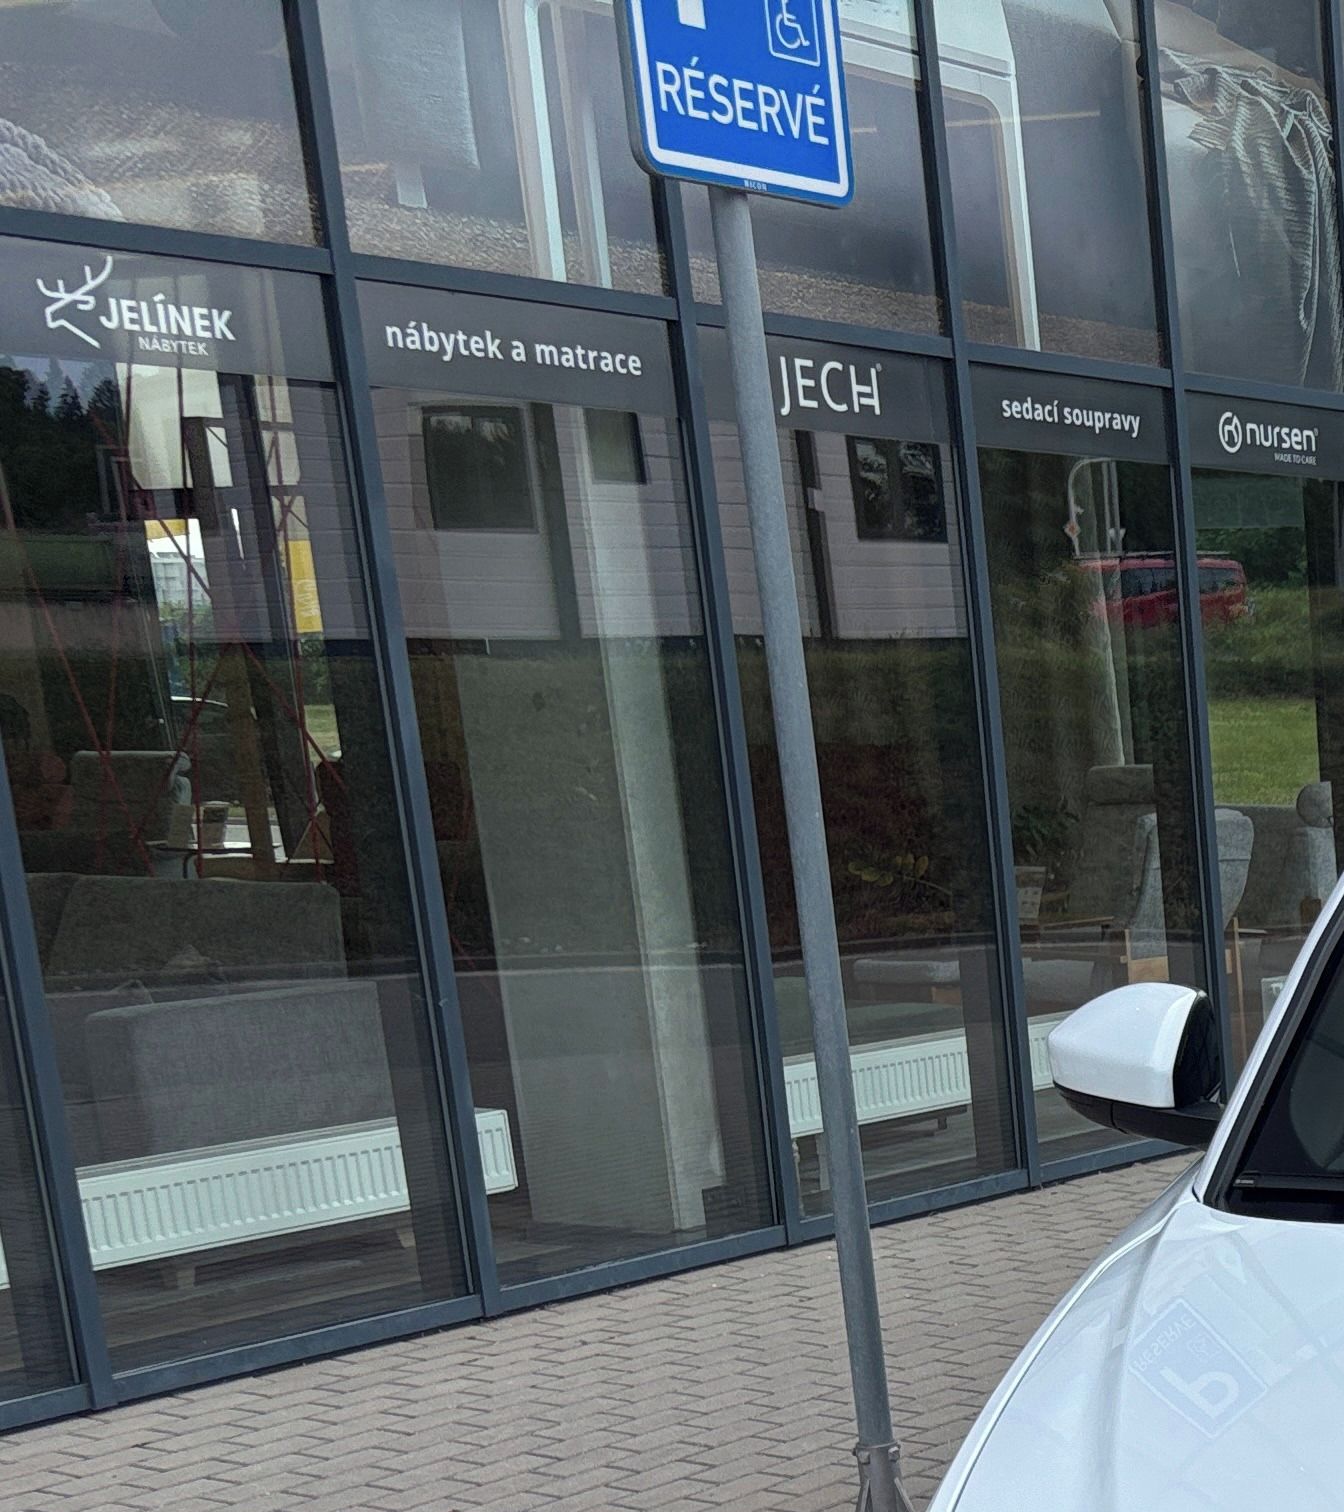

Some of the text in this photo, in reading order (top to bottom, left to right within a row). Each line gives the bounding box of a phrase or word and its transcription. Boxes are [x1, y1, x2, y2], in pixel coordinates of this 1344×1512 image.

[655, 56, 830, 146] RÉSERVÉ
[99, 292, 236, 341] JELÍNEK
[137, 335, 209, 356] NÁBYTEK
[385, 320, 643, 376] nábytek a matrace
[1002, 396, 1141, 438] sedací soupravy
